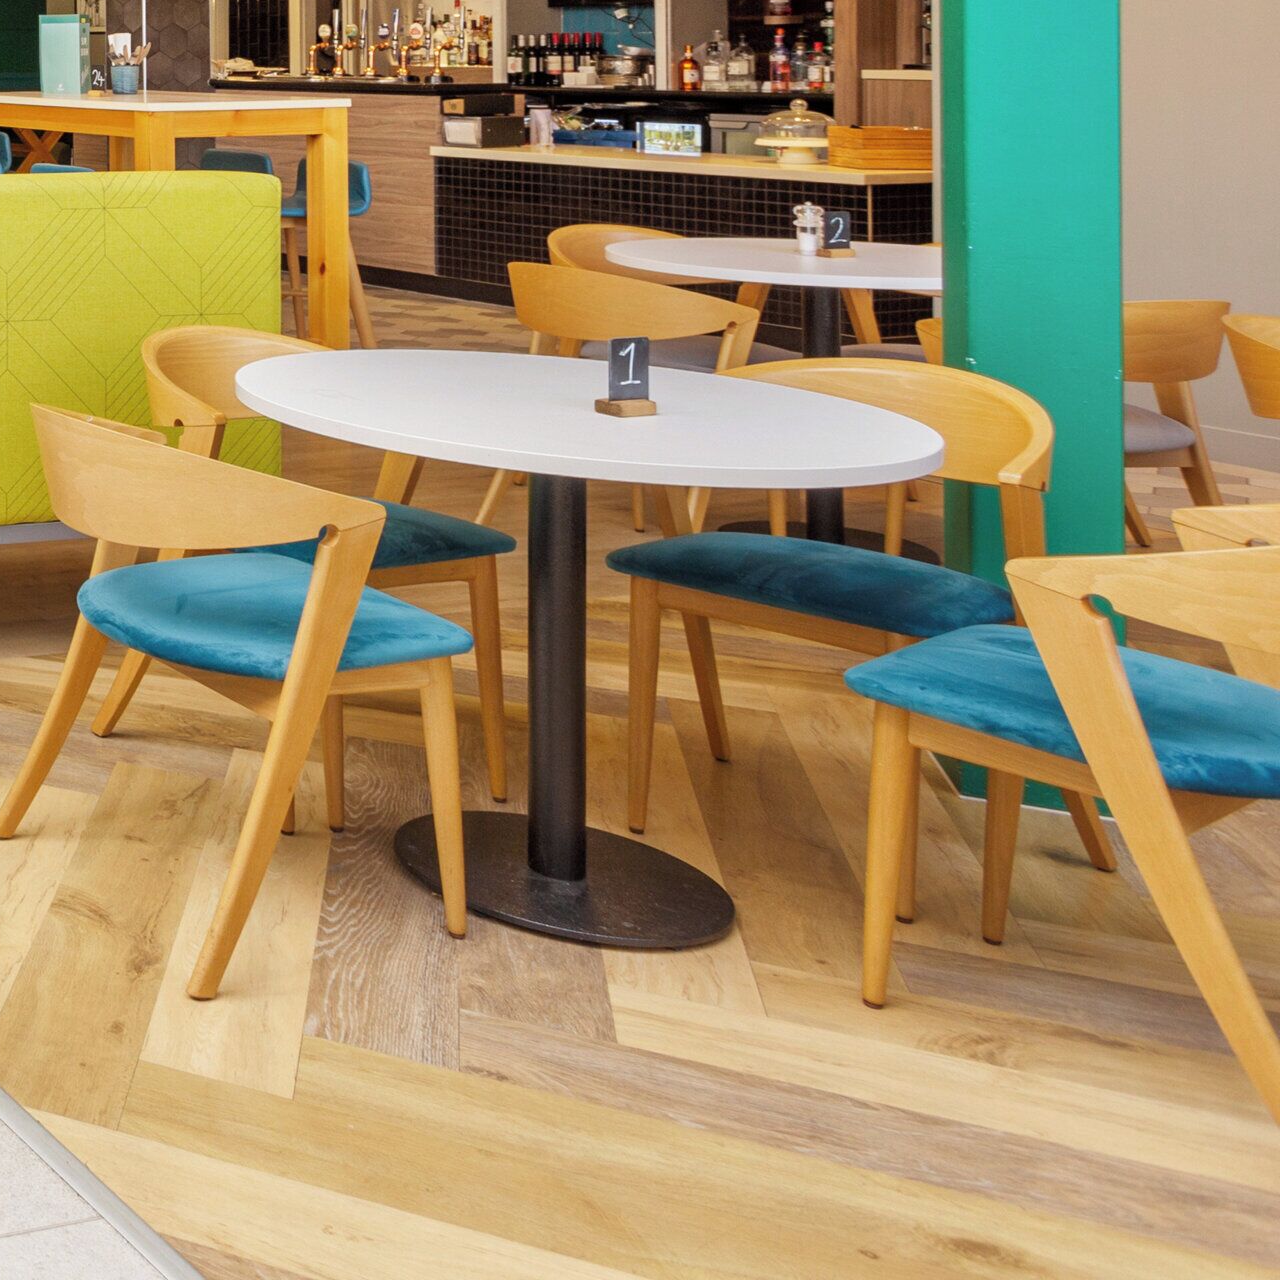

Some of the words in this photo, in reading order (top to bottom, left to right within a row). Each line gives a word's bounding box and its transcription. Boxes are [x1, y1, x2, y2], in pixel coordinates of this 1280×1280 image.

[92, 69, 105, 87] 24
[829, 216, 848, 244] 2
[618, 342, 641, 385] 1
